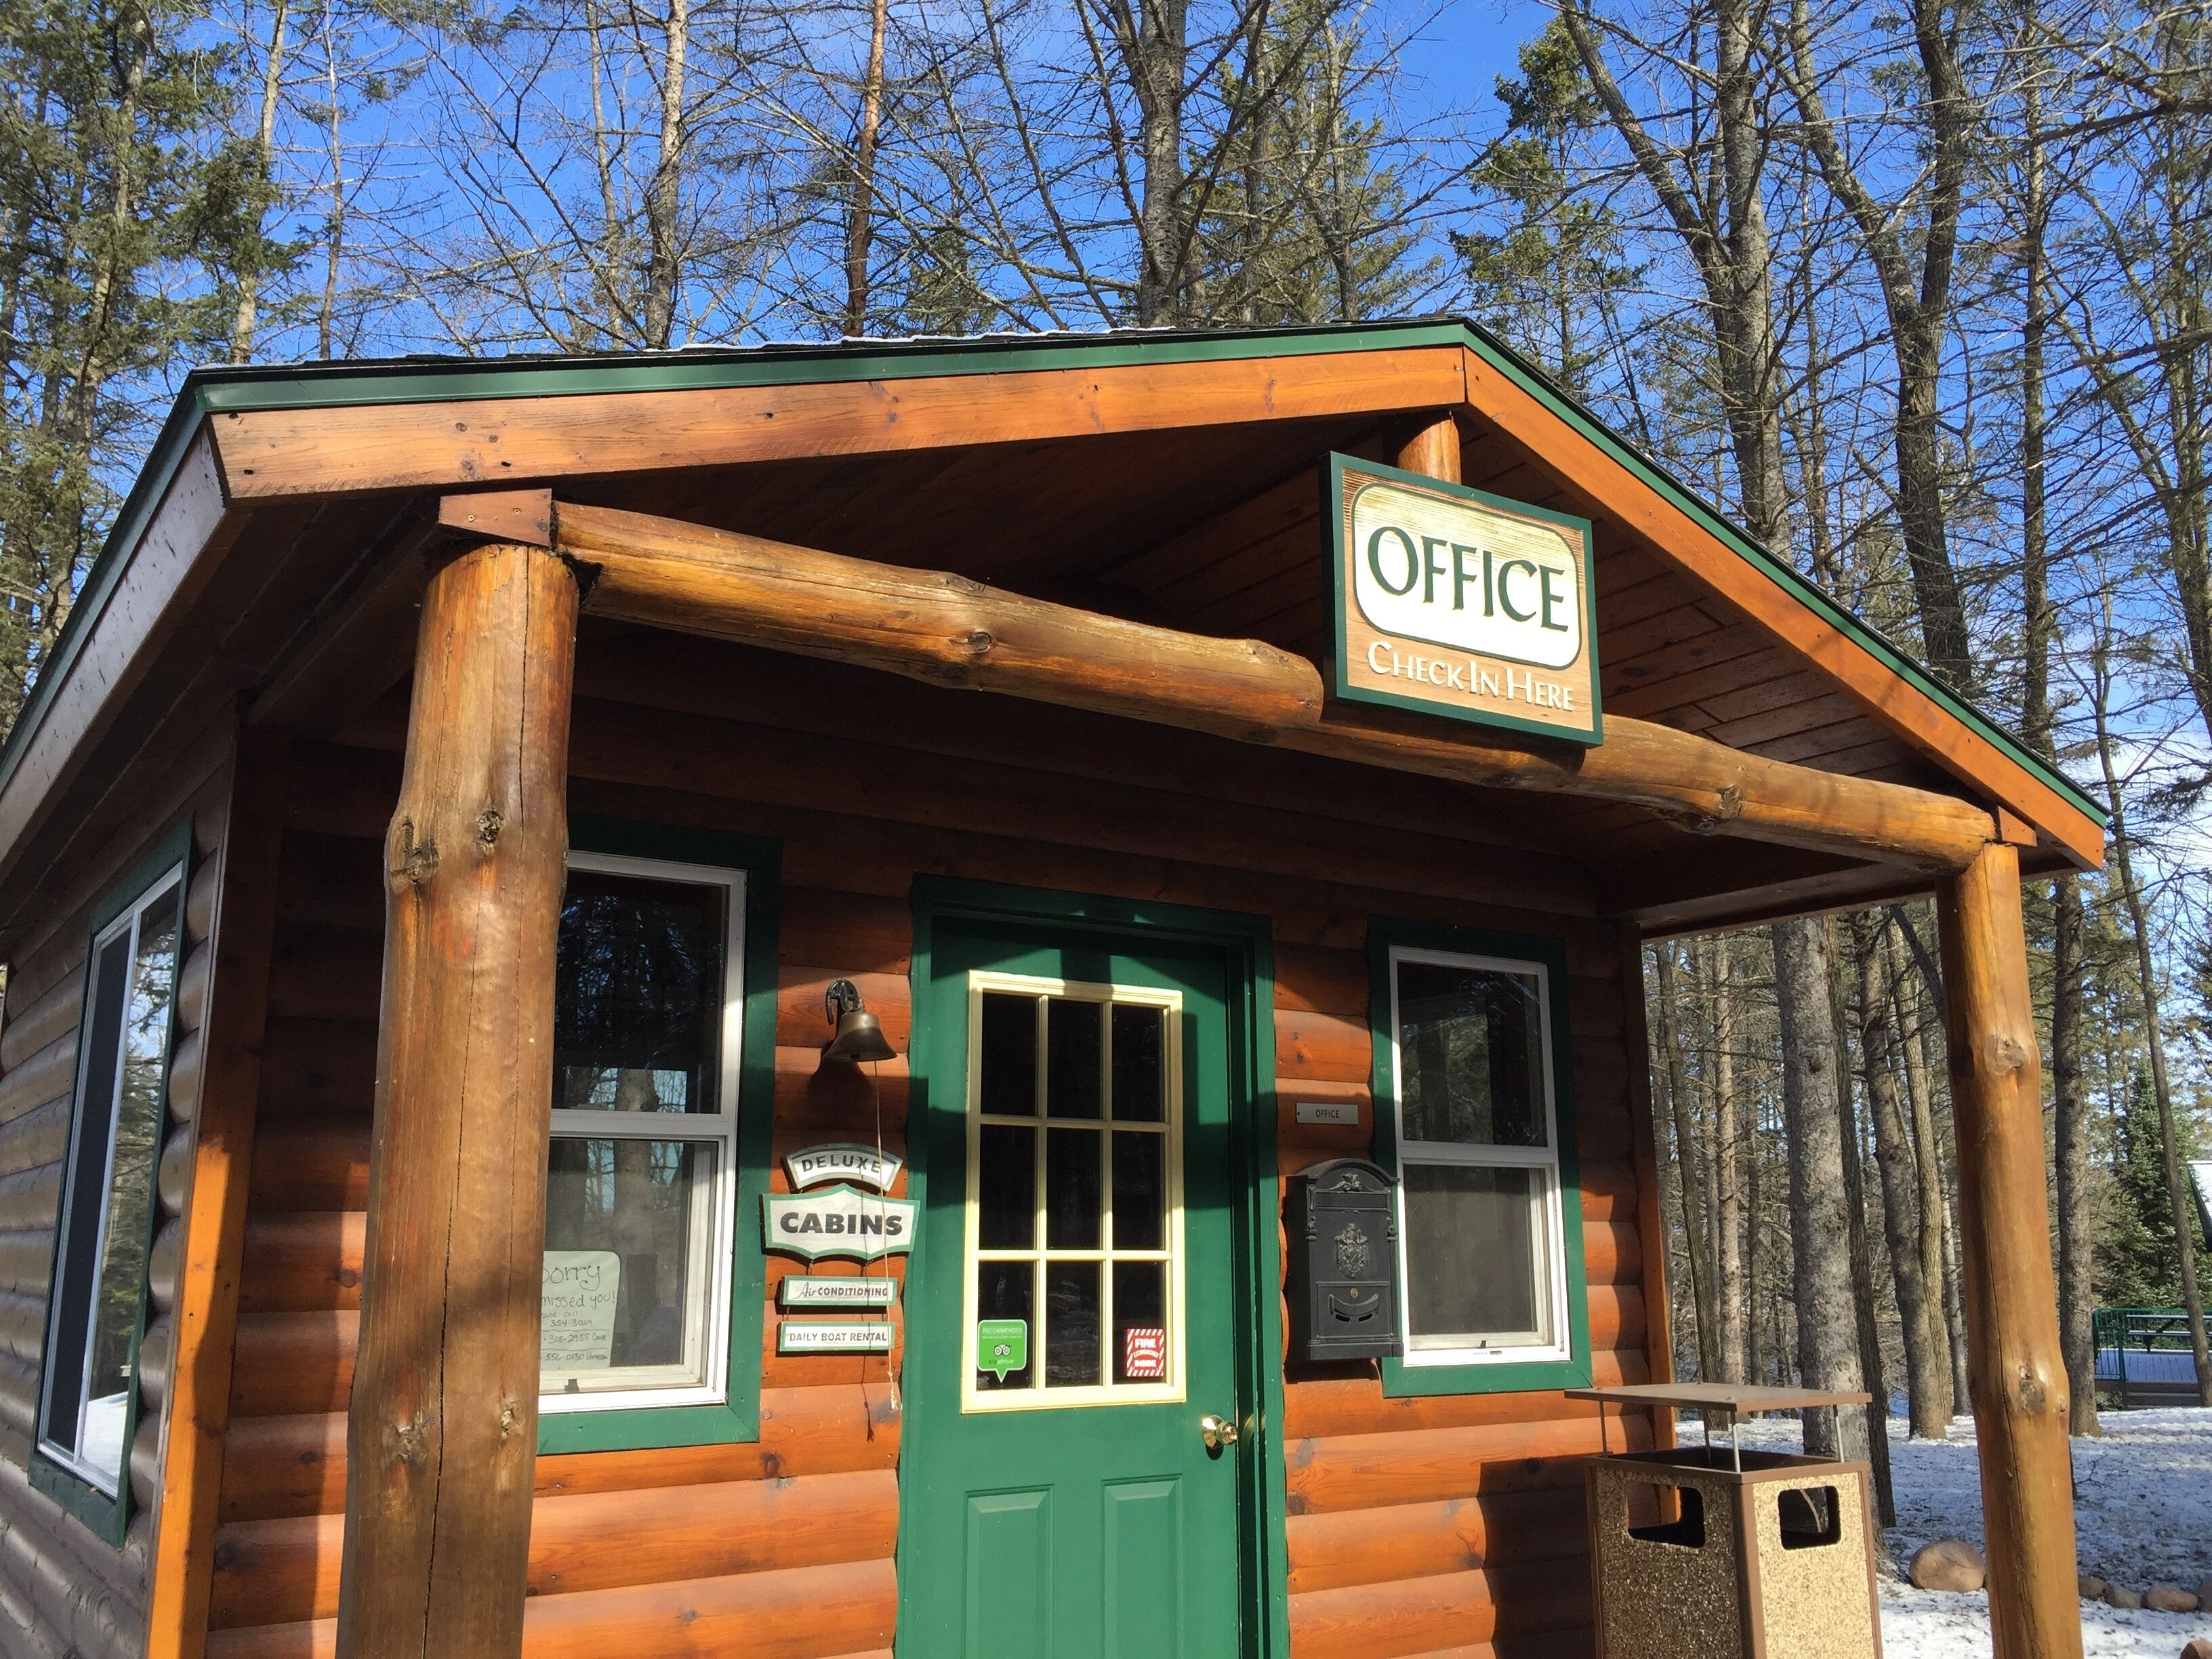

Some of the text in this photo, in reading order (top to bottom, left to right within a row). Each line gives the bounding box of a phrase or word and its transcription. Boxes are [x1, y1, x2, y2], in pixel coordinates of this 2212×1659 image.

[1368, 526, 1569, 632] OFFICE
[1315, 1109, 1340, 1119] OFFICE
[802, 1154, 881, 1174] DELUXE
[780, 1212, 903, 1236] CABINS
[817, 1287, 888, 1296] CONDITIONING
[790, 1332, 887, 1342] DAILY BOAT RENTAL
[1134, 1338, 1157, 1349] FIRE
